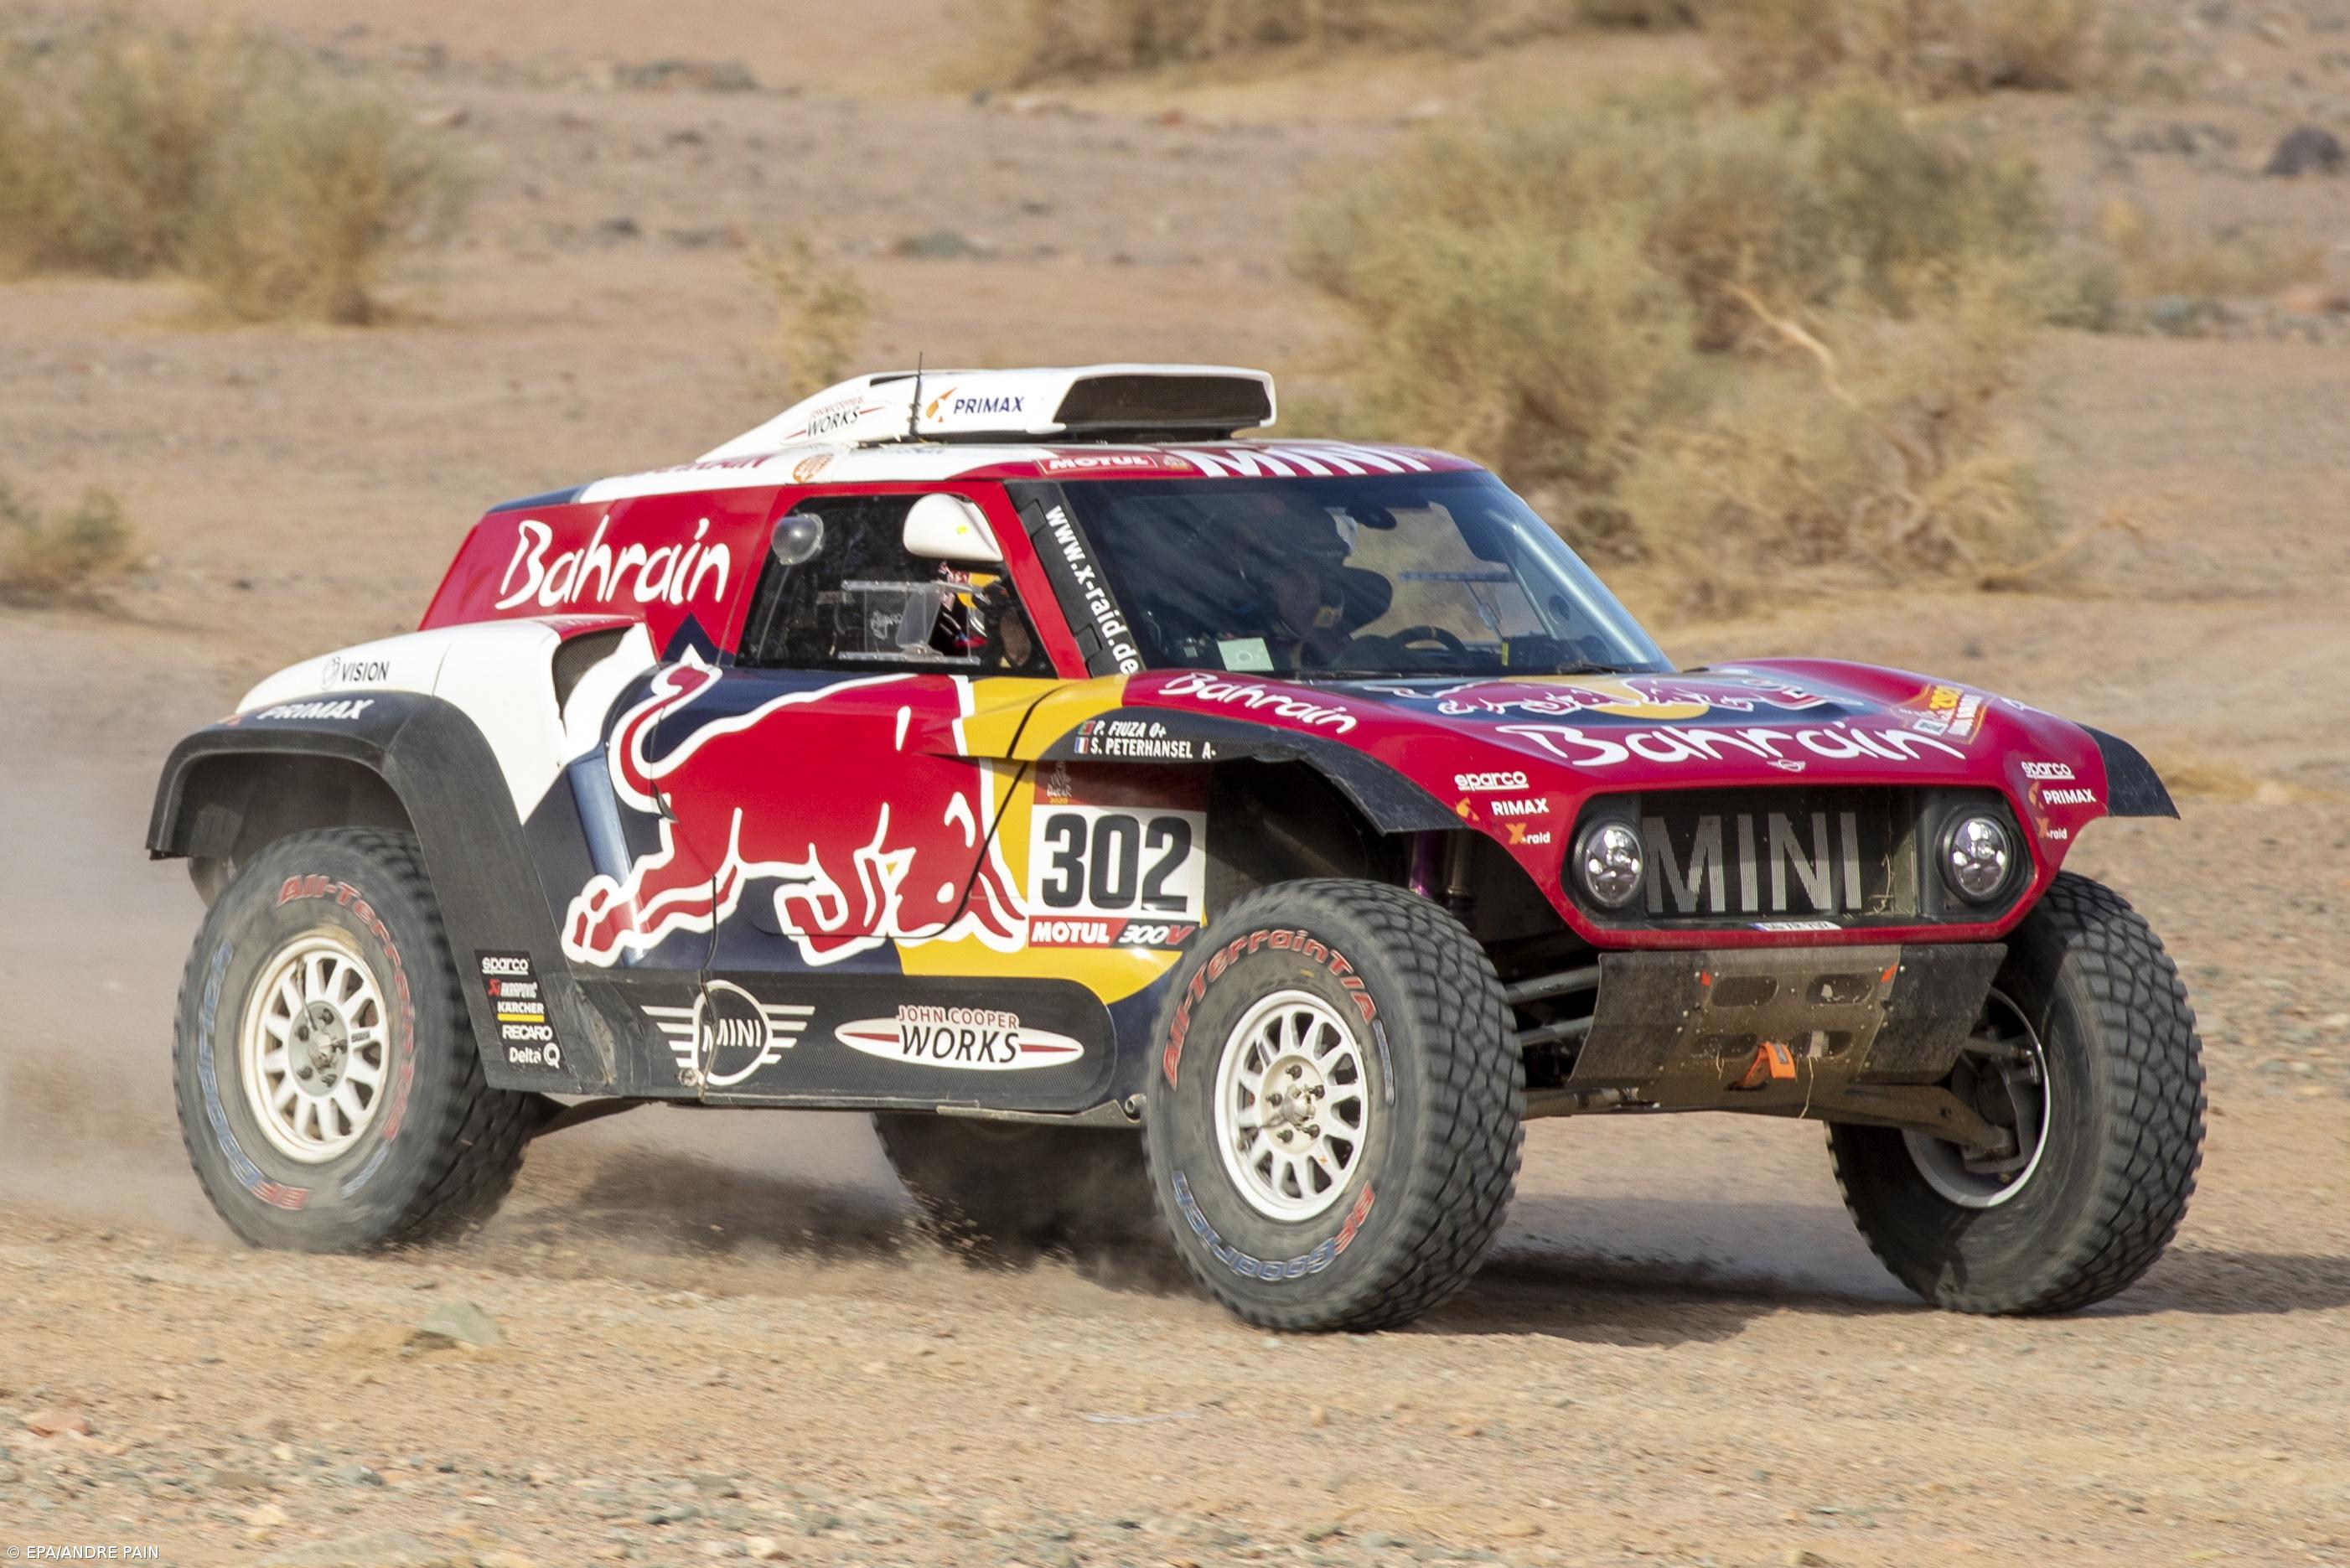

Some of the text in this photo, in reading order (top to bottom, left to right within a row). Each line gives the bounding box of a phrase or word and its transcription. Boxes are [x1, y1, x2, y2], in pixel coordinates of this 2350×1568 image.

[954, 396, 1024, 414] PRIMAX
[1049, 455, 1148, 470] MOTUL
[494, 514, 730, 610] Bahrain
[1045, 505, 1139, 675] www.x-raid.de
[341, 662, 390, 681] VISION
[256, 699, 375, 720] PRIMAX
[1158, 672, 1357, 734] Bahrain
[1093, 720, 1105, 736] P.
[1108, 721, 1147, 738] FIUZA
[1090, 737, 1103, 754] S.
[1105, 737, 1193, 759] PETERHANSEL
[1495, 720, 1966, 767] Bahrain
[1454, 770, 1530, 791] sparco
[2021, 761, 2075, 780] sparco
[2042, 789, 2097, 805] PRIMAX
[1042, 813, 1192, 913] 302
[1642, 811, 1862, 913] MINI
[1032, 922, 1196, 945] MOTUL 300V
[482, 957, 530, 975] sparco
[898, 1007, 1018, 1029] JOHN COOPER
[502, 1024, 553, 1041] RECARO
[701, 1018, 762, 1053] MINI
[901, 1024, 1019, 1063] WORKS
